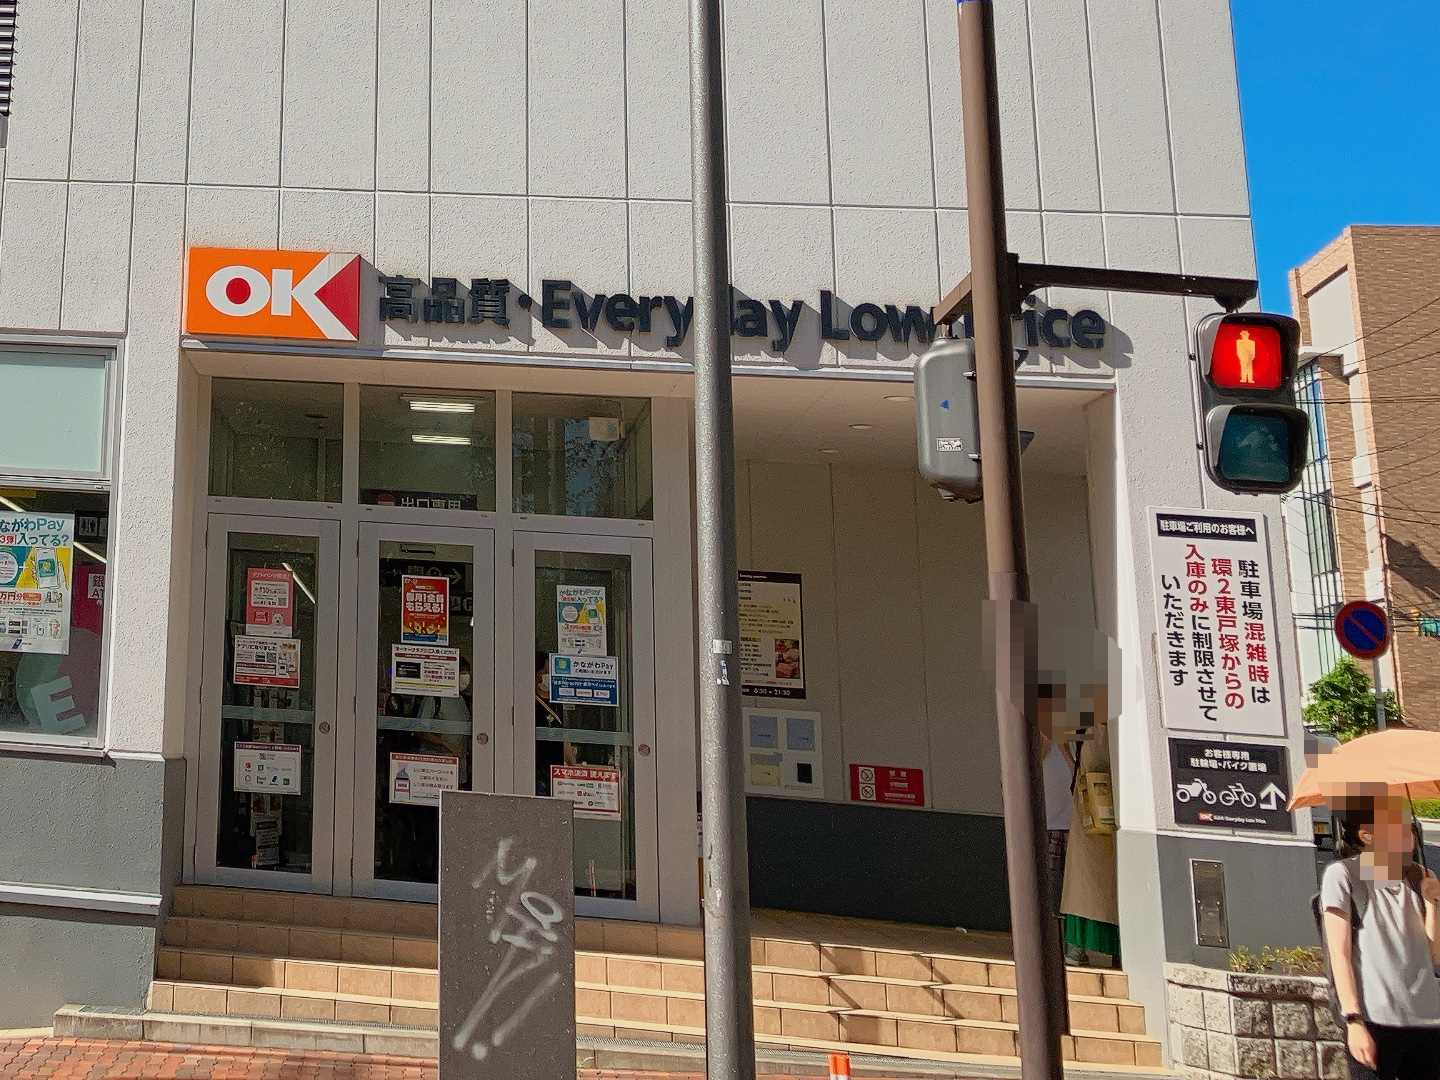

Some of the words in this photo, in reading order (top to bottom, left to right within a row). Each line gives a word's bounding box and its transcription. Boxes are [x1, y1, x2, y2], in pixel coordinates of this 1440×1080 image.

[205, 252, 358, 341] OK
[820, 289, 937, 344] Low
[1160, 519, 1255, 536] 駐車場ご利用のお客様へ
[1160, 574, 1189, 687] いただきます
[1184, 543, 1218, 722] 入庫のみに制限させて
[1238, 559, 1271, 704] 駐車場混雑時は
[572, 660, 614, 671] かながわPay
[1190, 757, 1268, 773] 駐輪場・バイク置場
[1204, 748, 1251, 761] お客様専用
